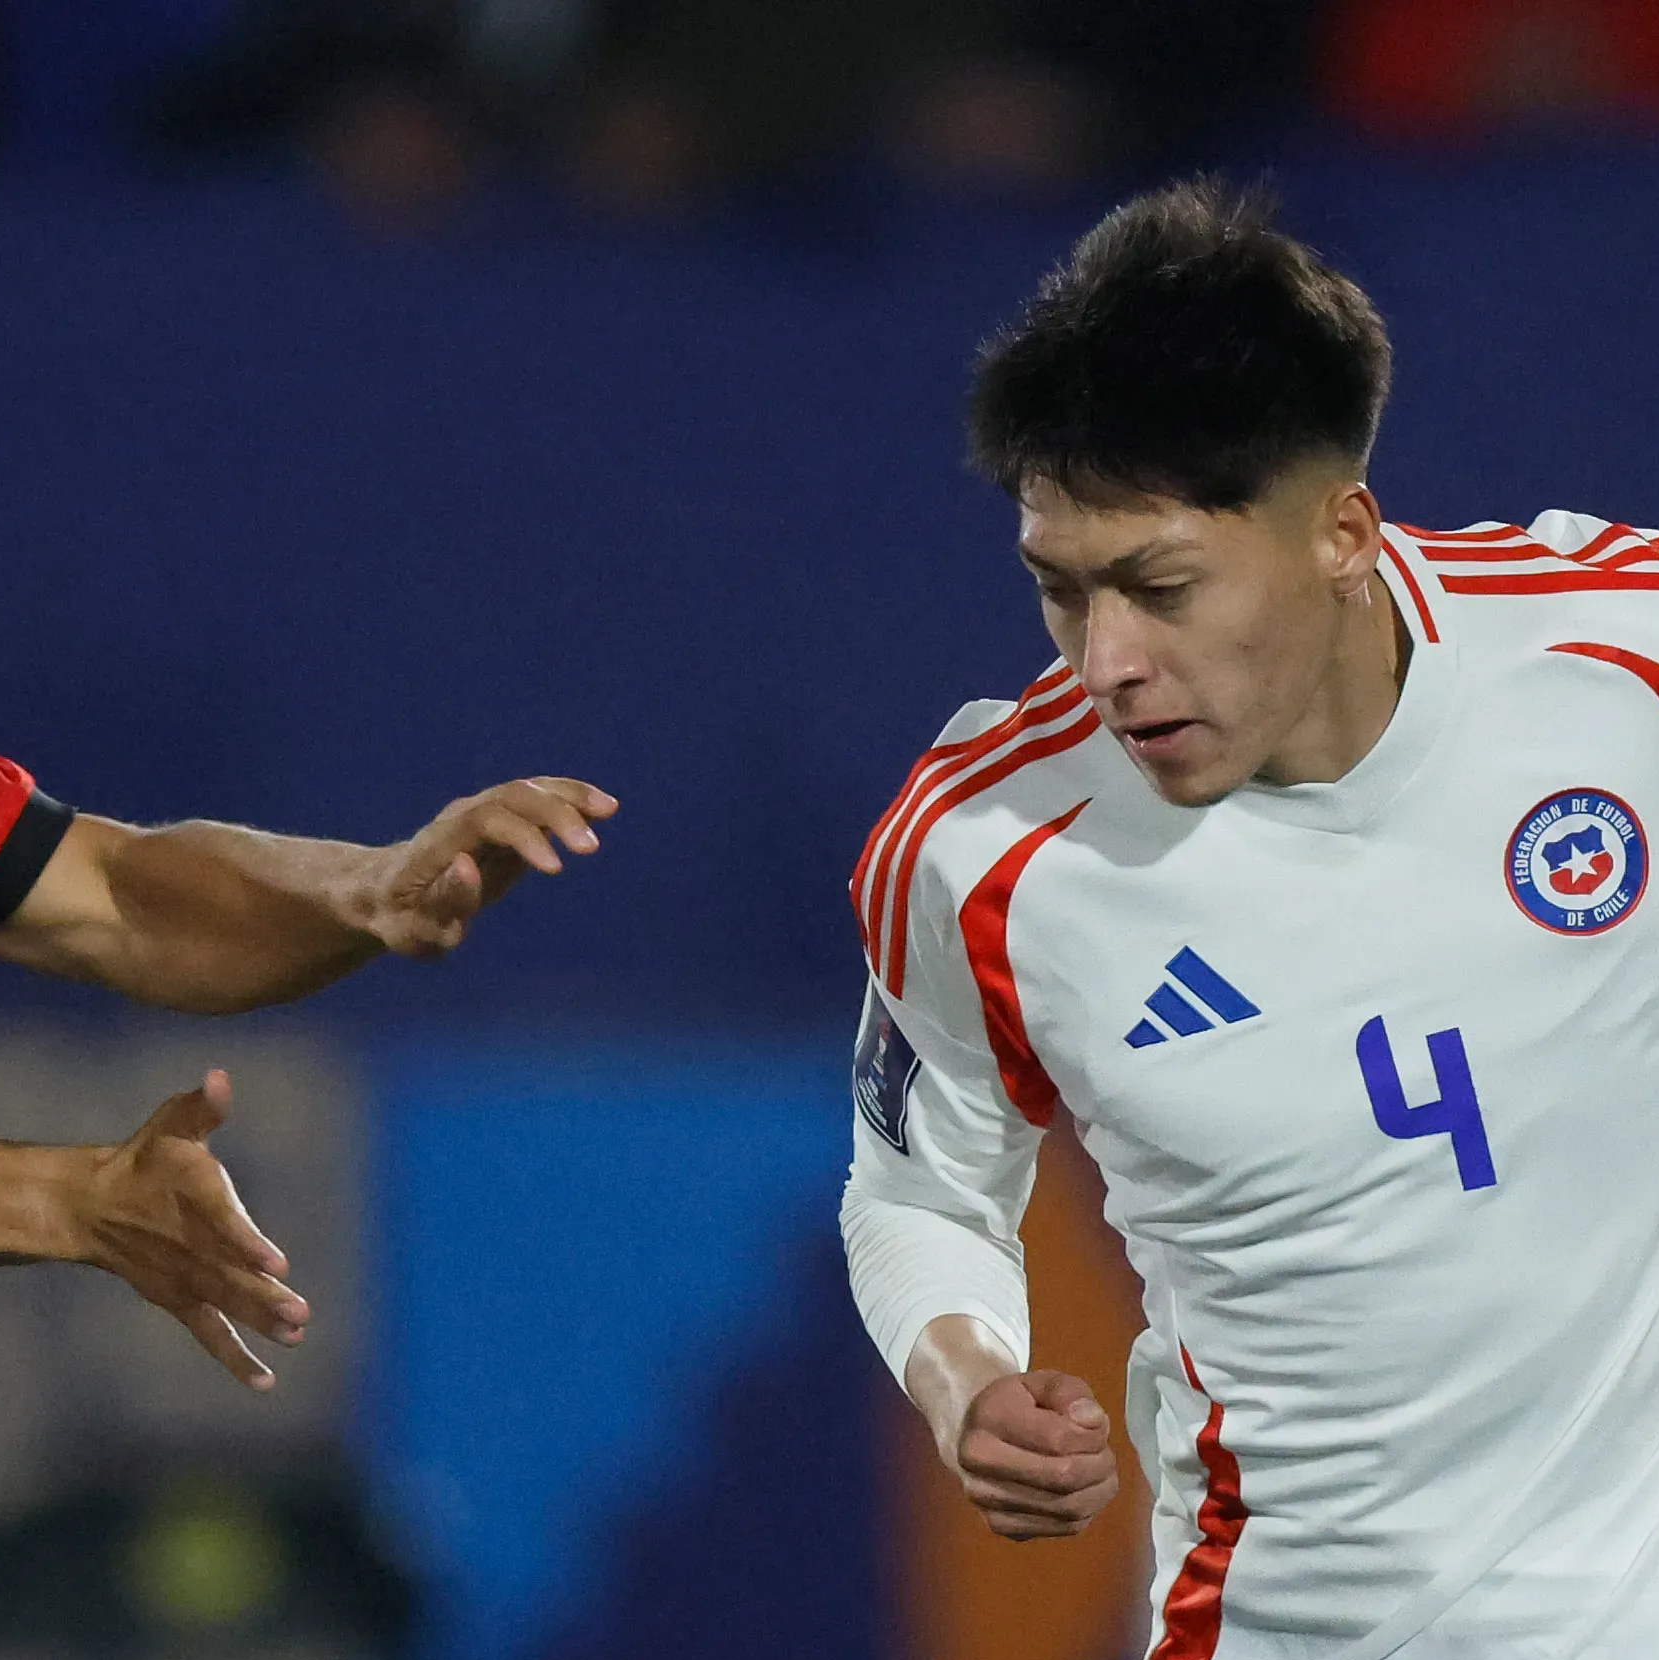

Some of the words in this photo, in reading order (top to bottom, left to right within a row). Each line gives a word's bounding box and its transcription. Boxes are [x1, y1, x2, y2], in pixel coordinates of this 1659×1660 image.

[1514, 803, 1563, 885] FEDERACION
[1571, 798, 1589, 813] DE
[1595, 801, 1636, 844] FUTBOL
[1566, 911, 1585, 927] DE
[1593, 889, 1630, 922] CHILE
[1356, 1014, 1497, 1192] 4
